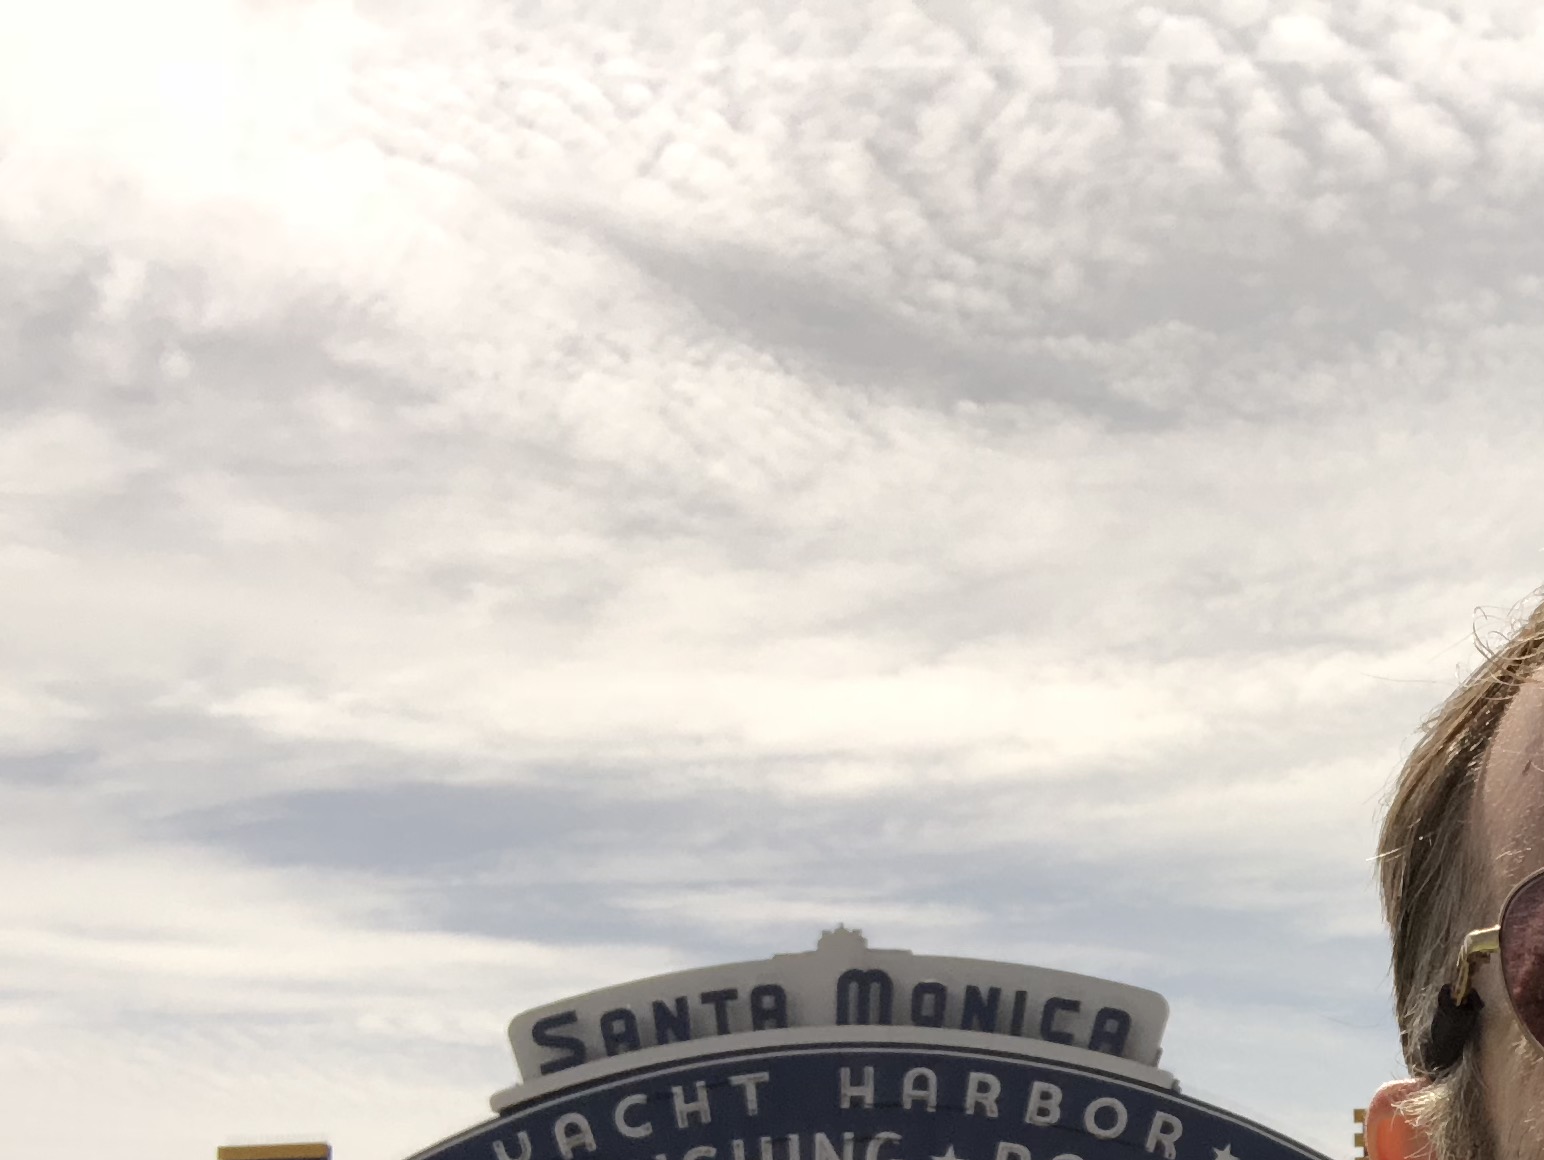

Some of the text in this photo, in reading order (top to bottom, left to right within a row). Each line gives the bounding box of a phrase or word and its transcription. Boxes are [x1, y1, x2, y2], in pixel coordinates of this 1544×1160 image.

[531, 968, 1133, 1075] SANTA MONICA
[840, 1066, 1184, 1160] HARBOR
